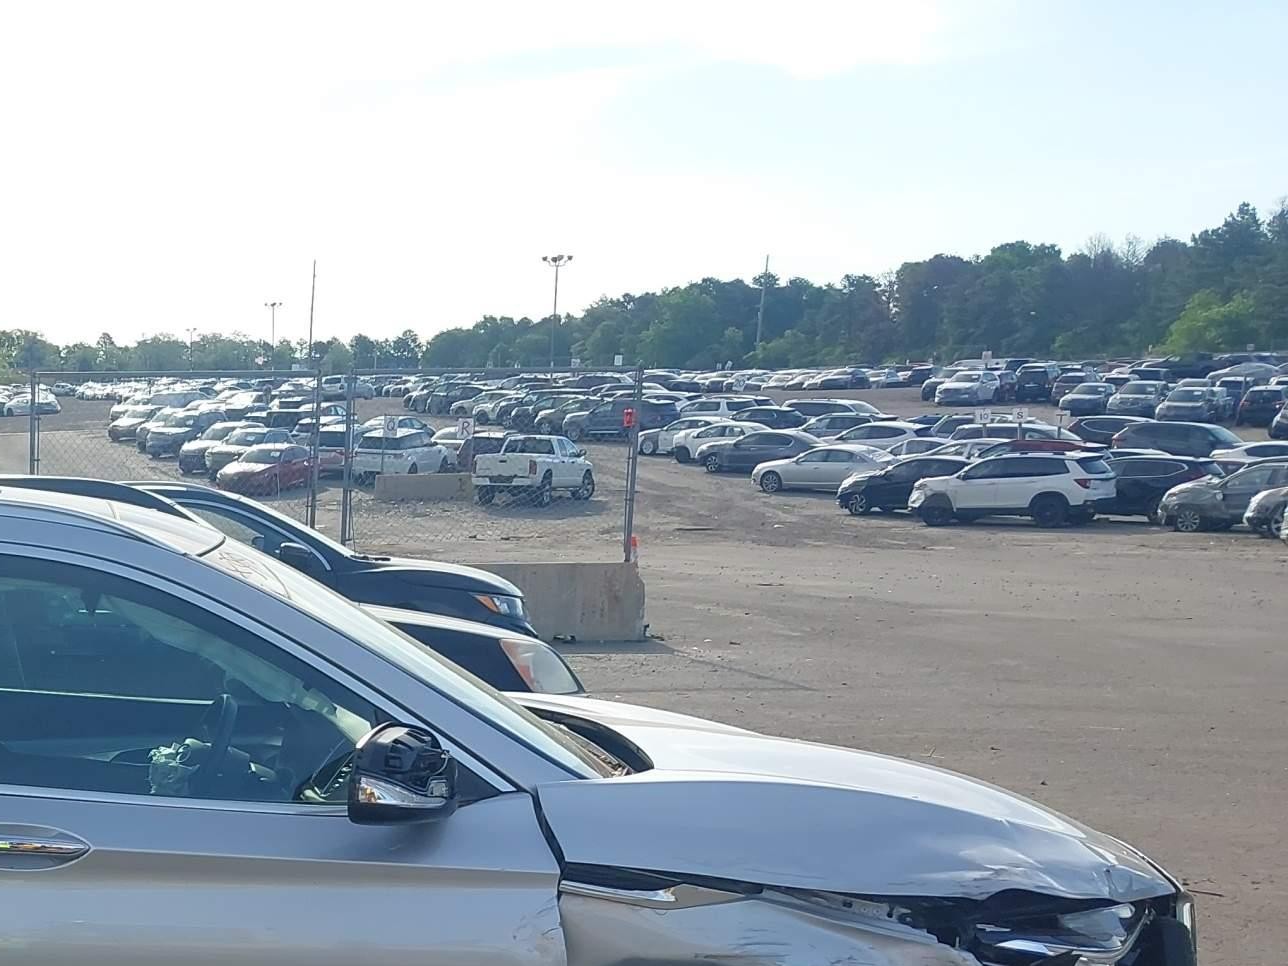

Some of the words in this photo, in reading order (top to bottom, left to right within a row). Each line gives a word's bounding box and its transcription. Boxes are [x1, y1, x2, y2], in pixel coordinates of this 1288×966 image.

[1016, 411, 1024, 419] S
[1056, 413, 1067, 424] T
[386, 420, 396, 432] Q
[461, 420, 471, 436] R
